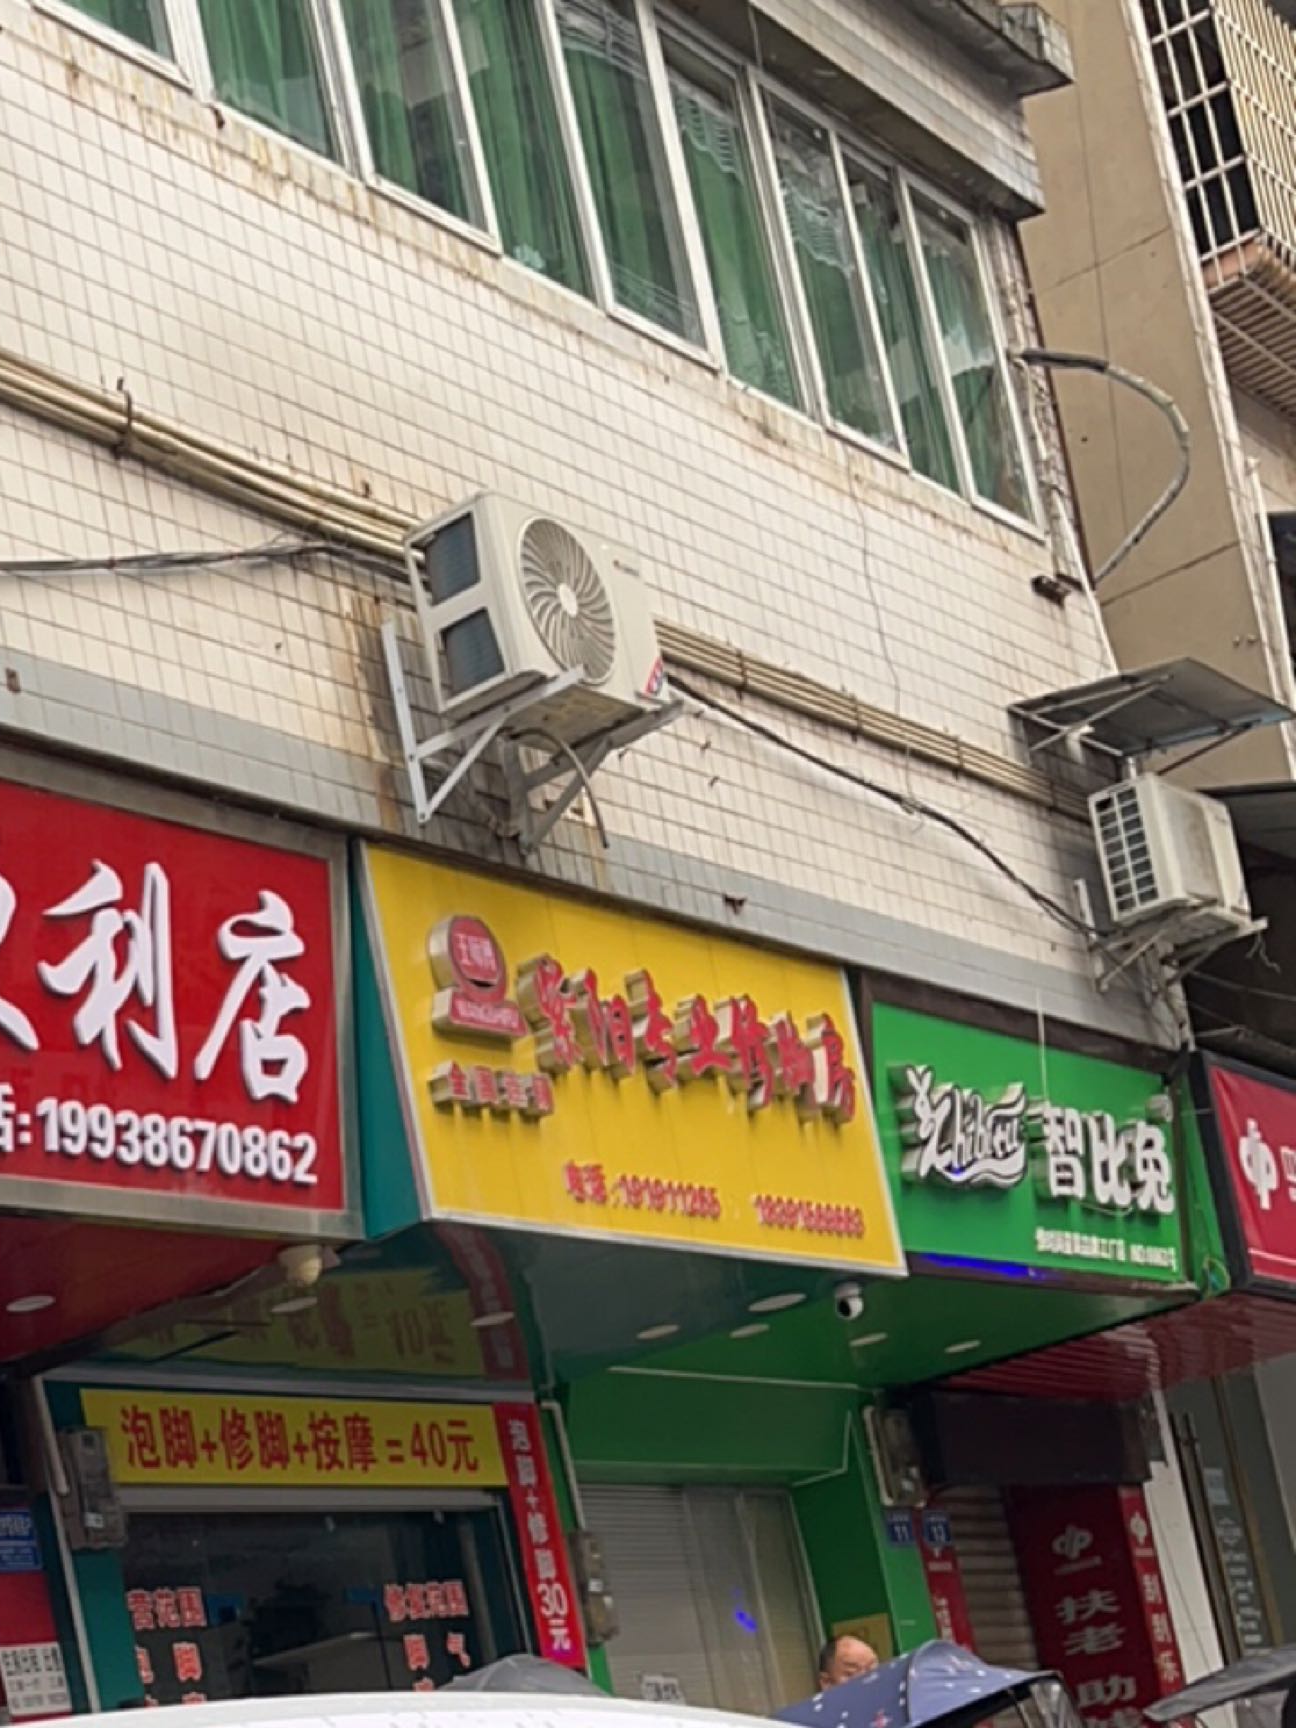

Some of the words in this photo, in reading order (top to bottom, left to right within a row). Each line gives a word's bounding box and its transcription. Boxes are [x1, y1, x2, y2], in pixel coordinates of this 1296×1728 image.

[1043, 1106, 1175, 1215] 智比兔
[120, 1404, 480, 1475] 泡脚+修脚+按摩=40元
